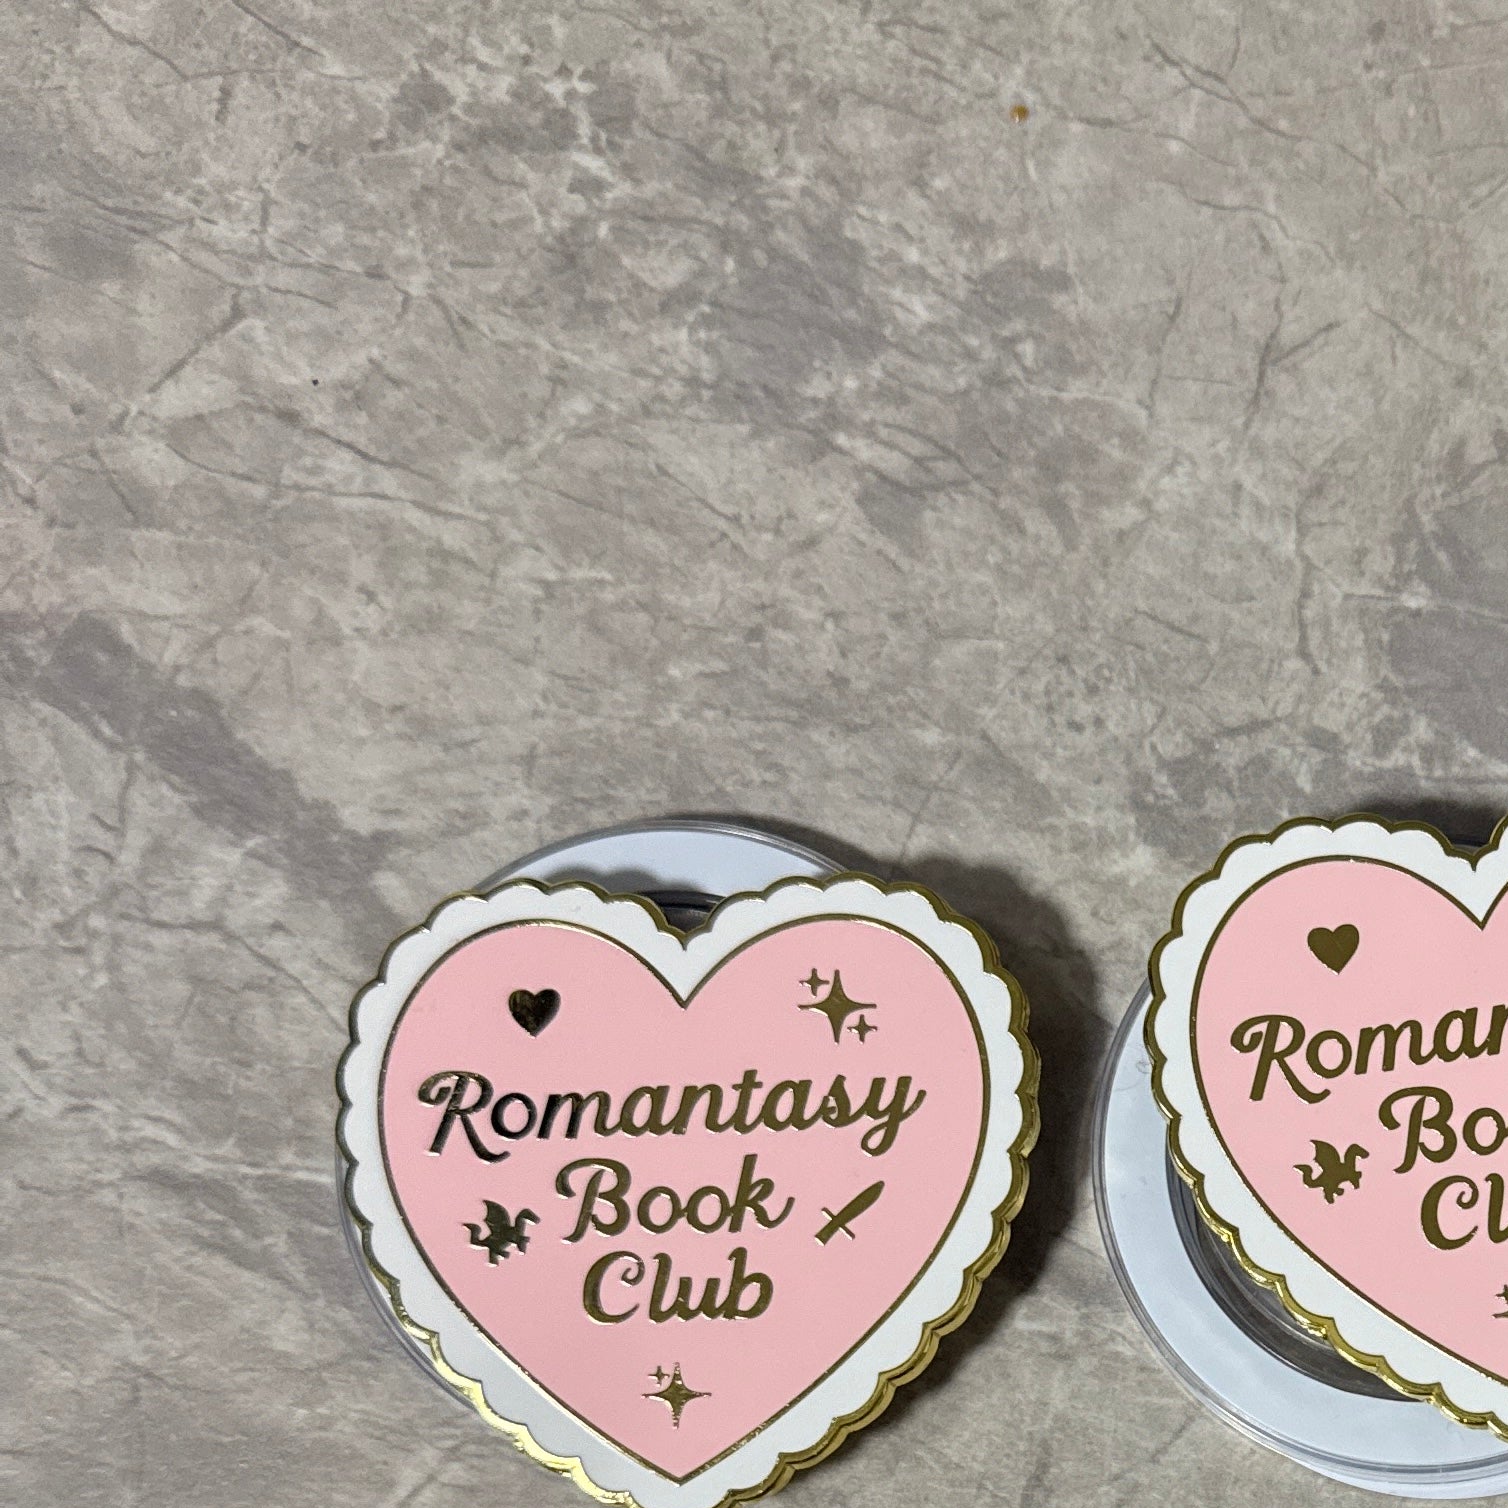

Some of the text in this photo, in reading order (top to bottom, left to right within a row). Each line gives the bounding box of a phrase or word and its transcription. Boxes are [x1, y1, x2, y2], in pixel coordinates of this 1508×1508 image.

[418, 1069, 927, 1163] Romantasy
[555, 1155, 795, 1244] Book
[583, 1248, 774, 1326] Club
